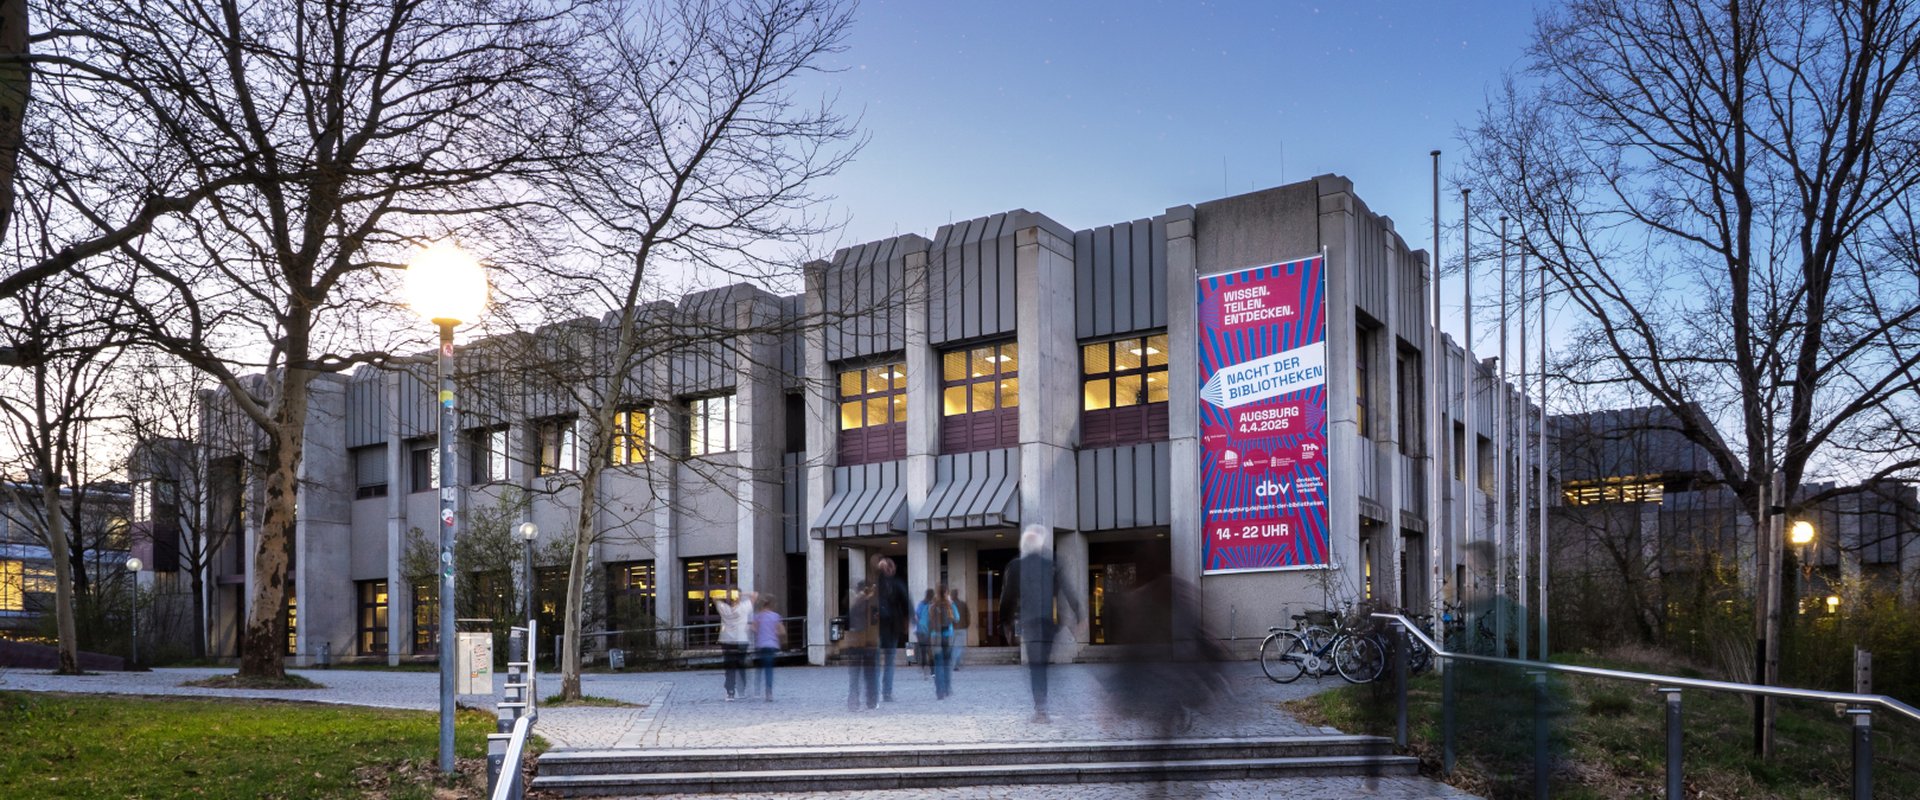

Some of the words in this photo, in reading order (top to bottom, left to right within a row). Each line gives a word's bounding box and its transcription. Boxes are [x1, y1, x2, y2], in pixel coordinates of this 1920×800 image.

[1224, 285, 1270, 302] WISSEN.
[1224, 298, 1266, 314] TEILEN.
[1224, 305, 1294, 326] ENTDECKEN.
[1227, 364, 1270, 386] NACHT
[1274, 356, 1300, 373] DER
[1229, 365, 1323, 400] BIBLIOTHEKEN
[1239, 406, 1299, 423] AUGSBURG
[1239, 419, 1289, 434] 4.4.2025
[1255, 480, 1290, 497] dbv
[1216, 527, 1231, 541] 14
[1242, 525, 1259, 539] 22
[1261, 523, 1289, 538] UHR
